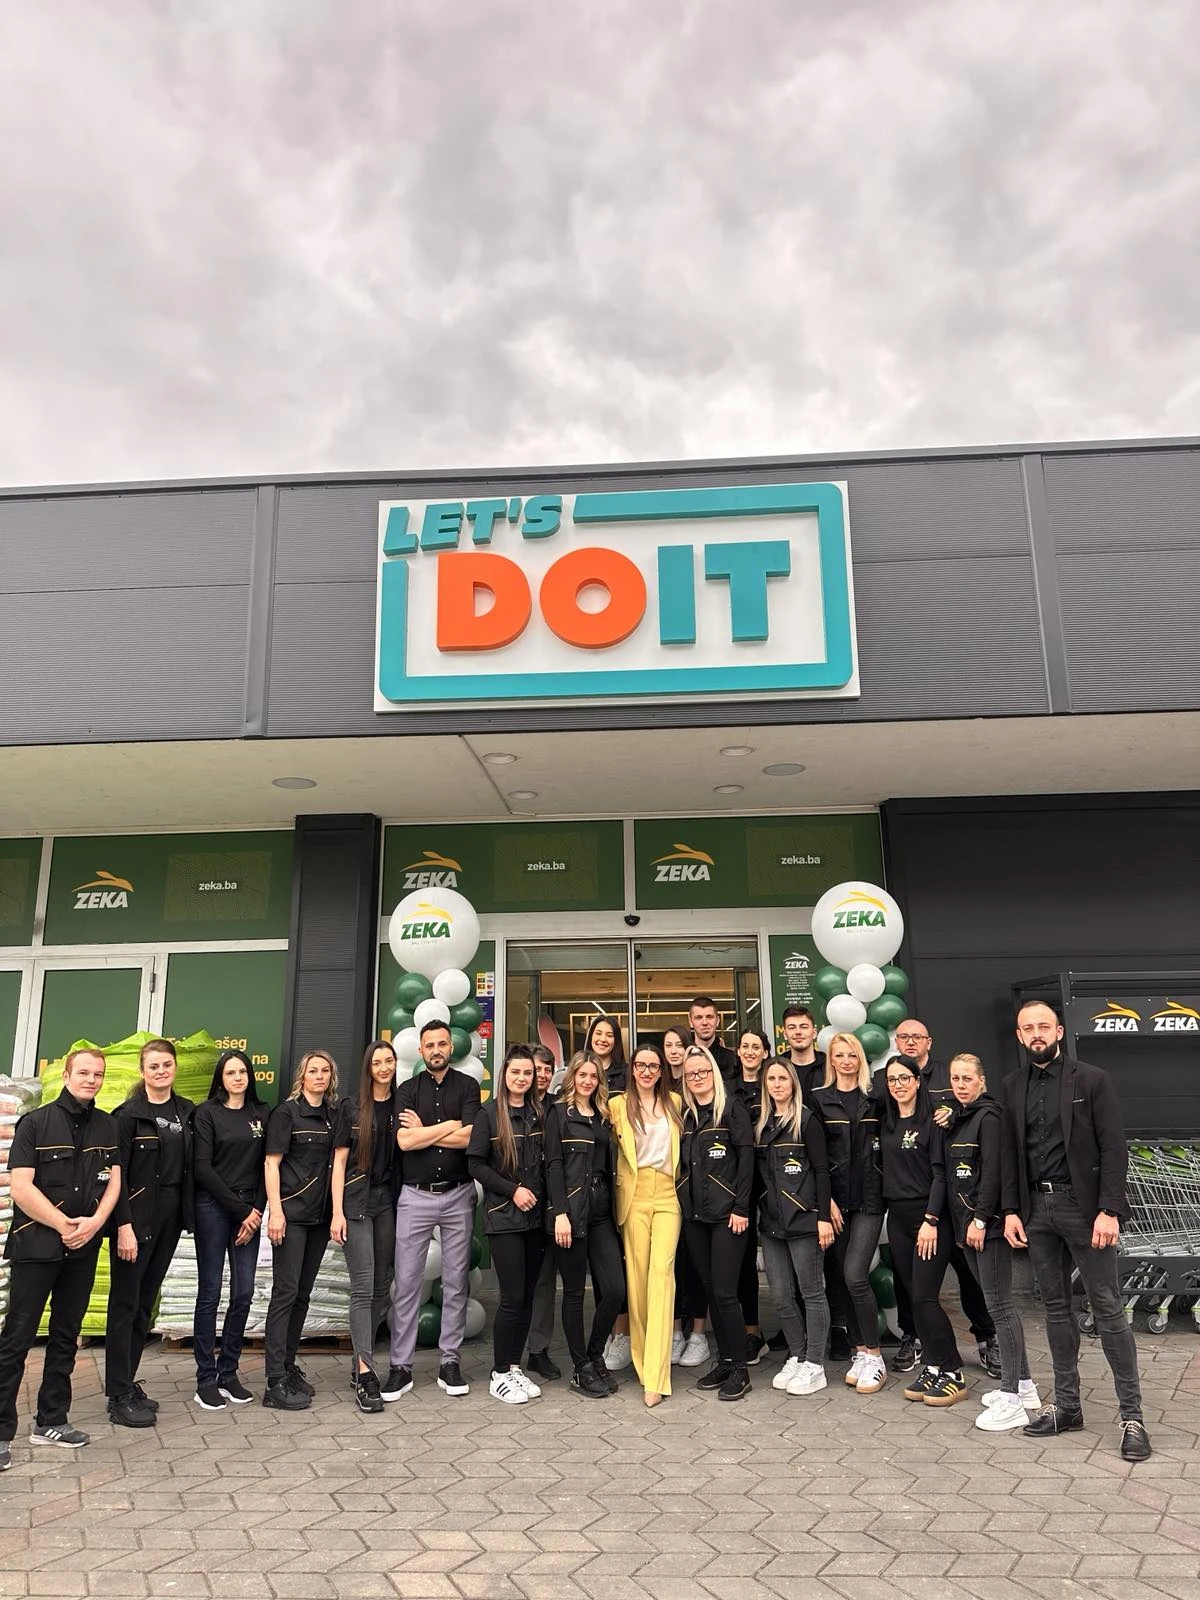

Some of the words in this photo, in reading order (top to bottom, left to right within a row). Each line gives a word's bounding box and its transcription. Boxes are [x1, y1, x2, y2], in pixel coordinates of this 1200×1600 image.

[383, 495, 562, 556] LET'S
[527, 861, 565, 871] zeka.ba
[781, 855, 821, 865] zeka.ba
[402, 871, 458, 889] ZEKA
[655, 864, 711, 882] ZEKA
[198, 880, 237, 891] zeka.ba
[73, 891, 129, 910] ZEKA
[833, 910, 886, 929] ZEKA
[400, 921, 451, 940] ZEKA
[785, 961, 808, 969] ZEKA
[1093, 1018, 1139, 1032] ZEKA
[1153, 1016, 1199, 1031] ZEKA
[214, 1036, 248, 1052] ašeg
